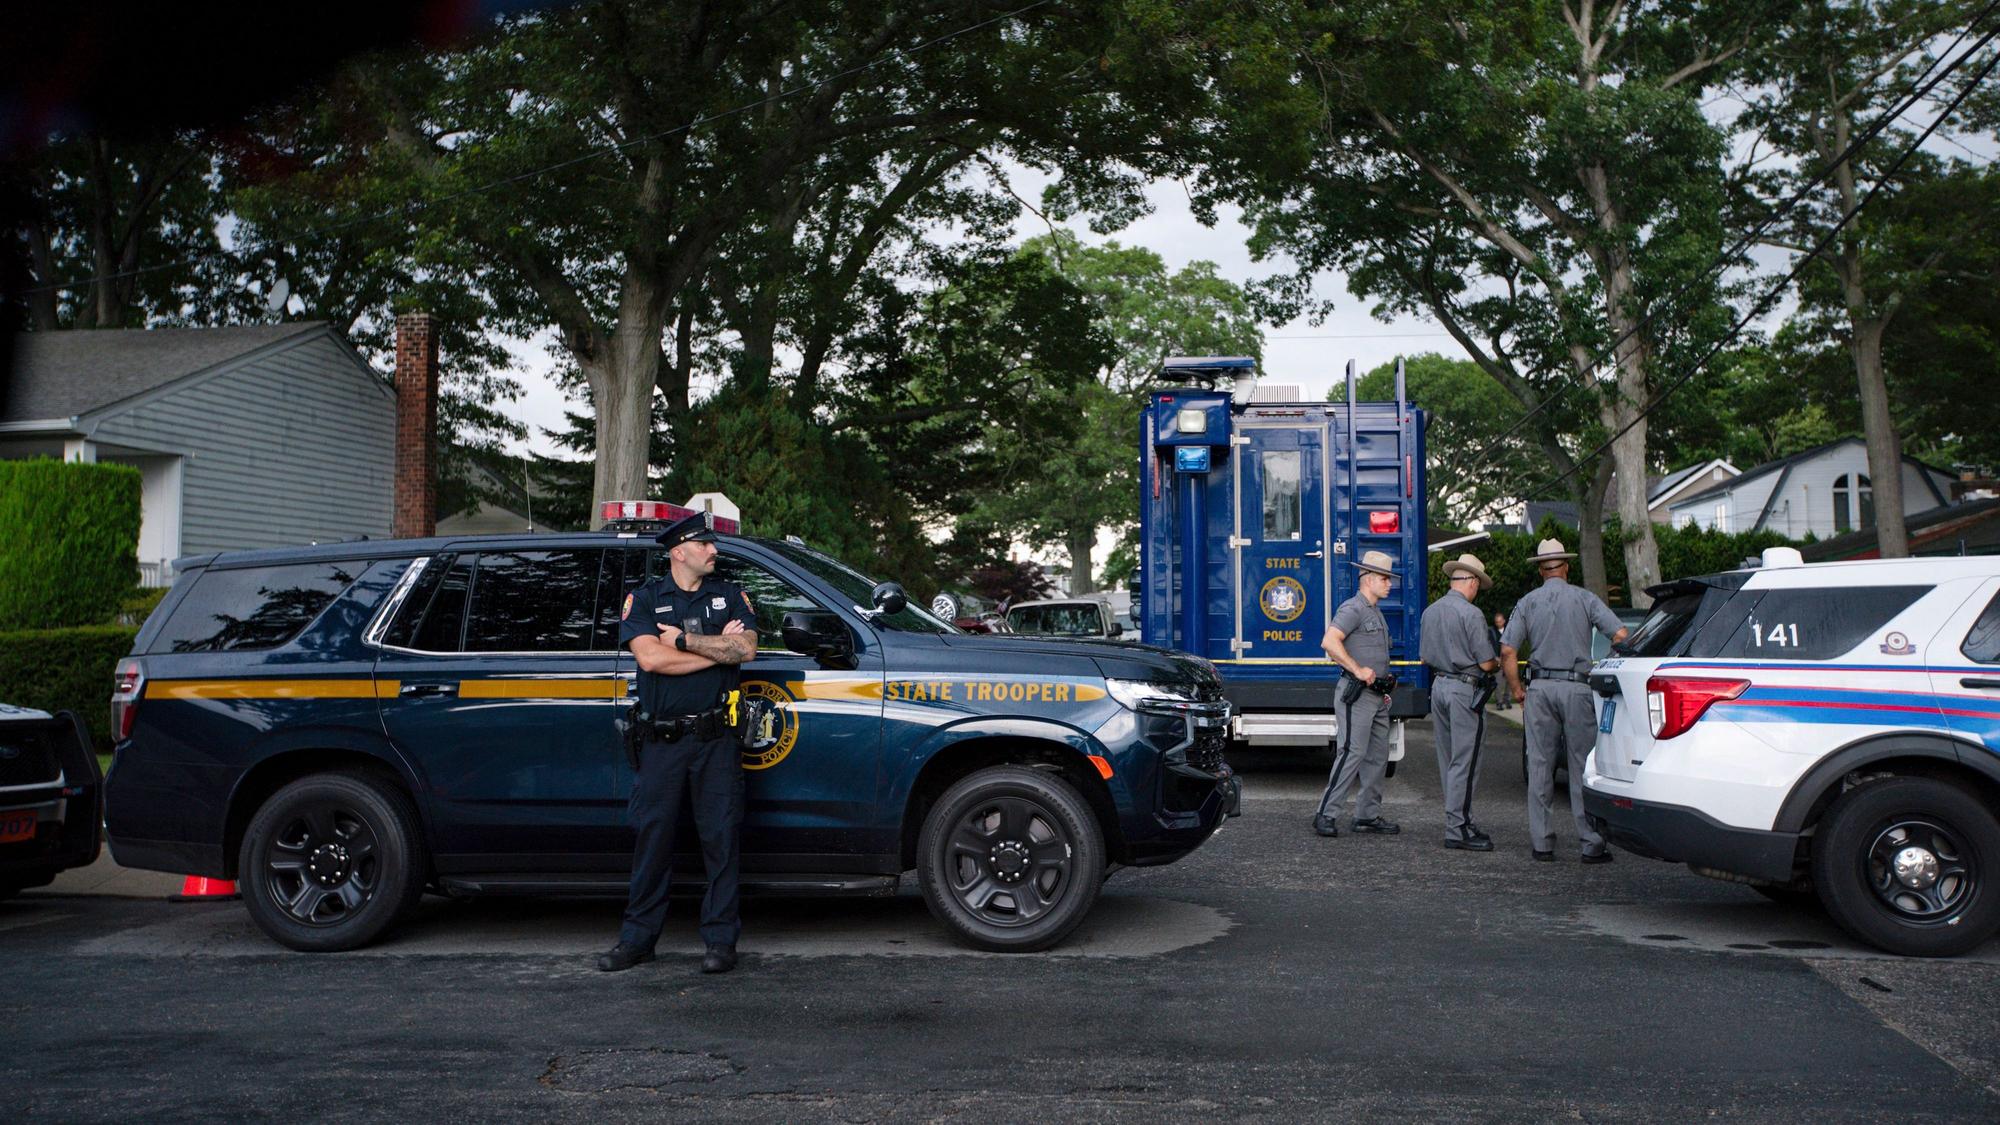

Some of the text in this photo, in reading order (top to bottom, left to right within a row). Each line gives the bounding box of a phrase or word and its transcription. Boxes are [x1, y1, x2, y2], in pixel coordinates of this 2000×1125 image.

[1265, 558, 1300, 569] STATE
[1263, 630, 1302, 641] POLICE
[1752, 623, 1799, 647] 141
[886, 681, 1069, 702] STATE TROOPER
[761, 727, 794, 765] POLICE
